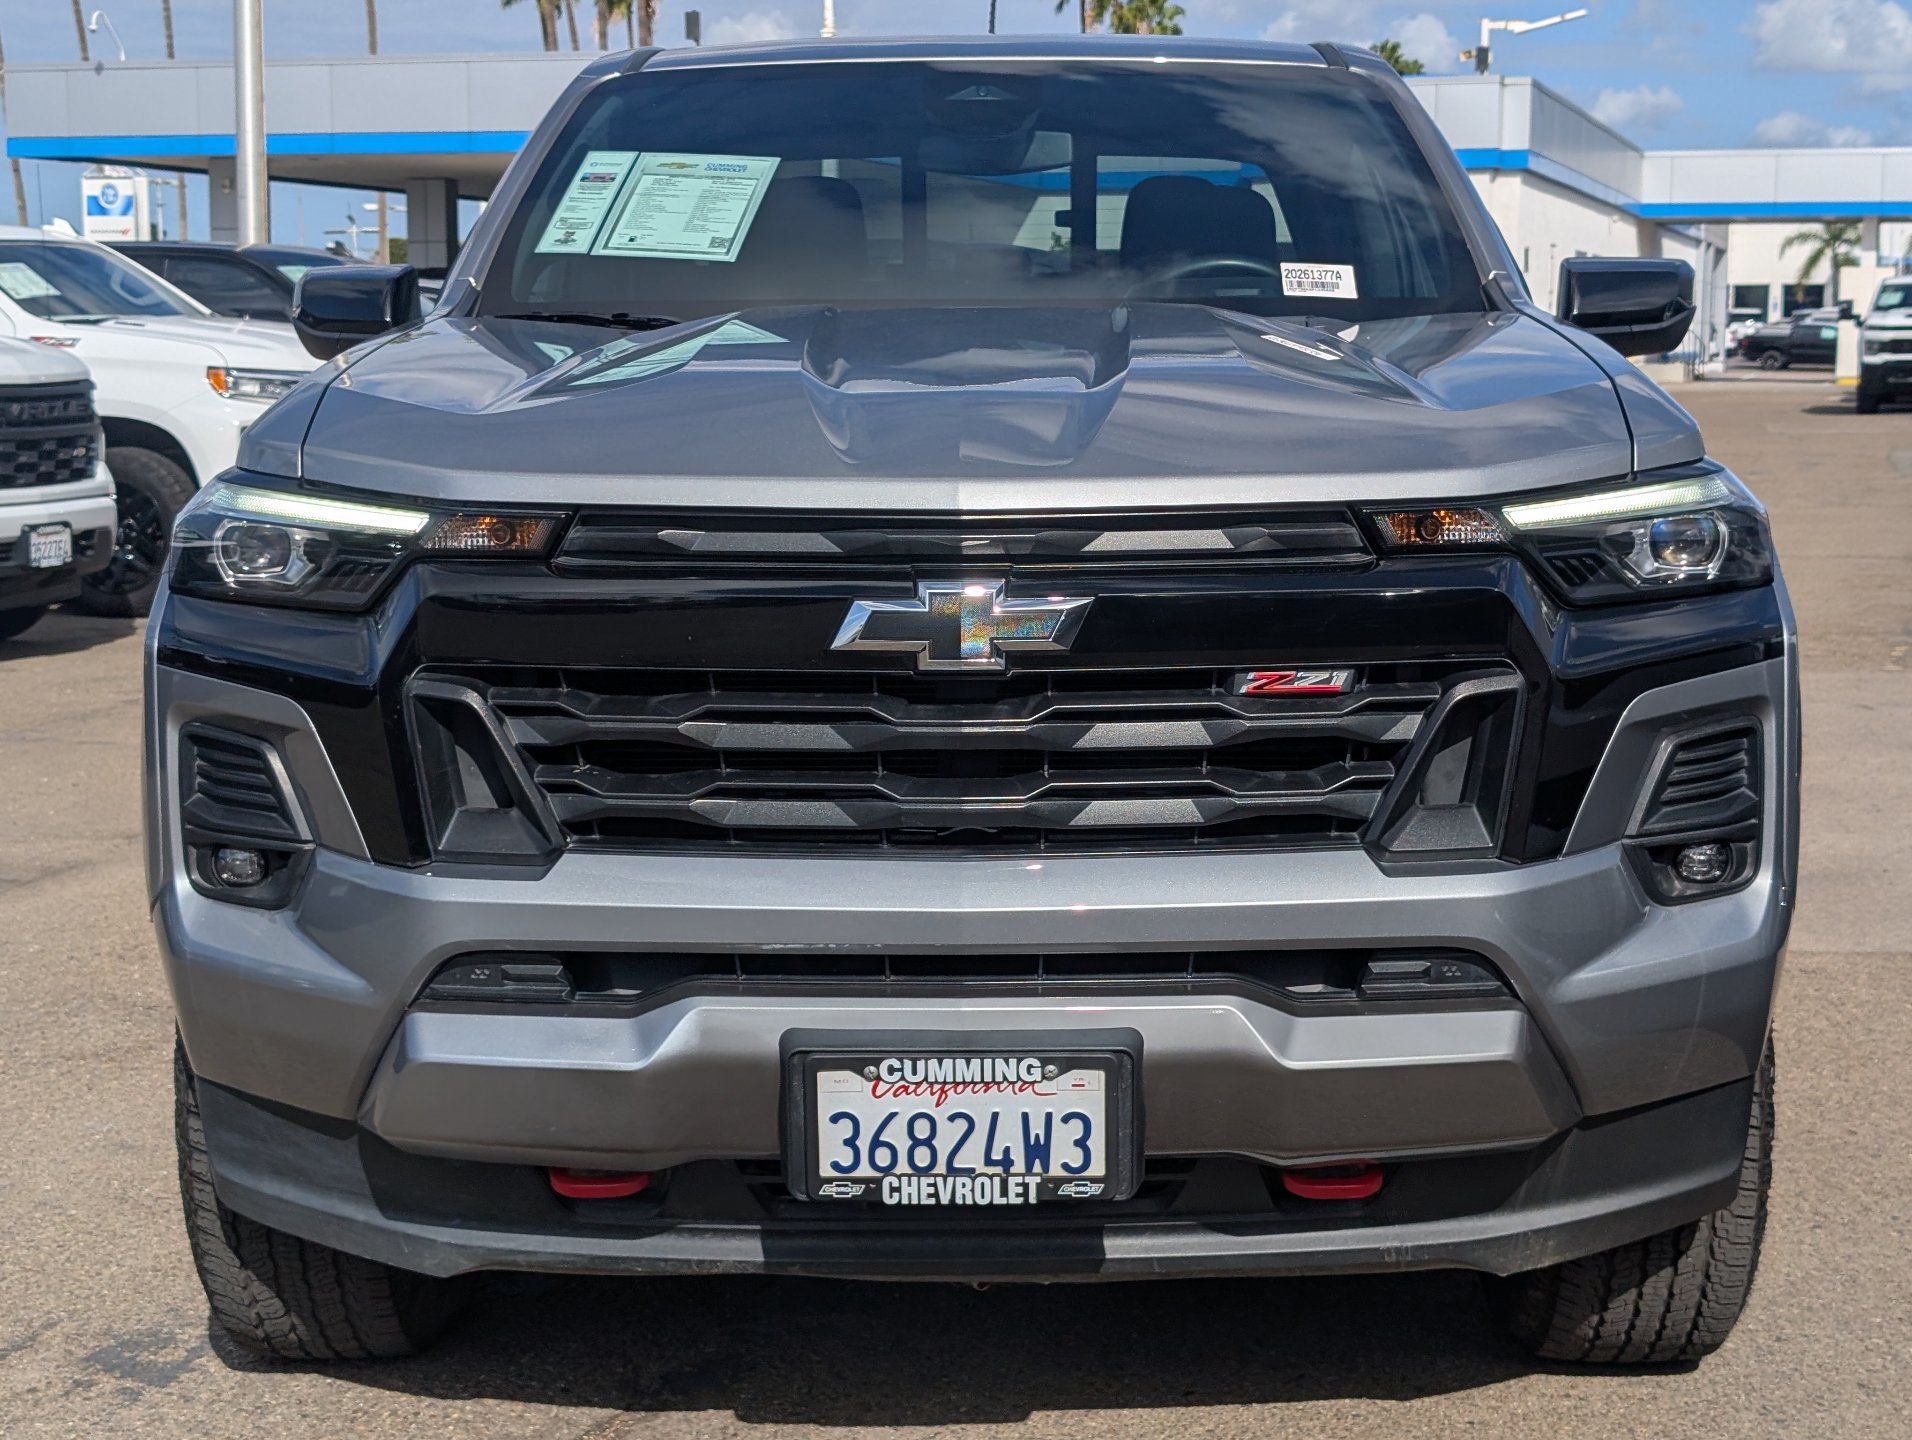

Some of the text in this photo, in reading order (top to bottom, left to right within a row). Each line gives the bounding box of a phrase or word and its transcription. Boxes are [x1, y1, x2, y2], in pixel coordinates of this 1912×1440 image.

[706, 162, 748, 170] CUMMING
[1284, 268, 1342, 281] 20261377A
[1239, 671, 1348, 695] Z71
[879, 1057, 1043, 1083] CUMMING
[828, 1110, 1092, 1175] 36824W3
[882, 1175, 1042, 1205] CHEVROLET
